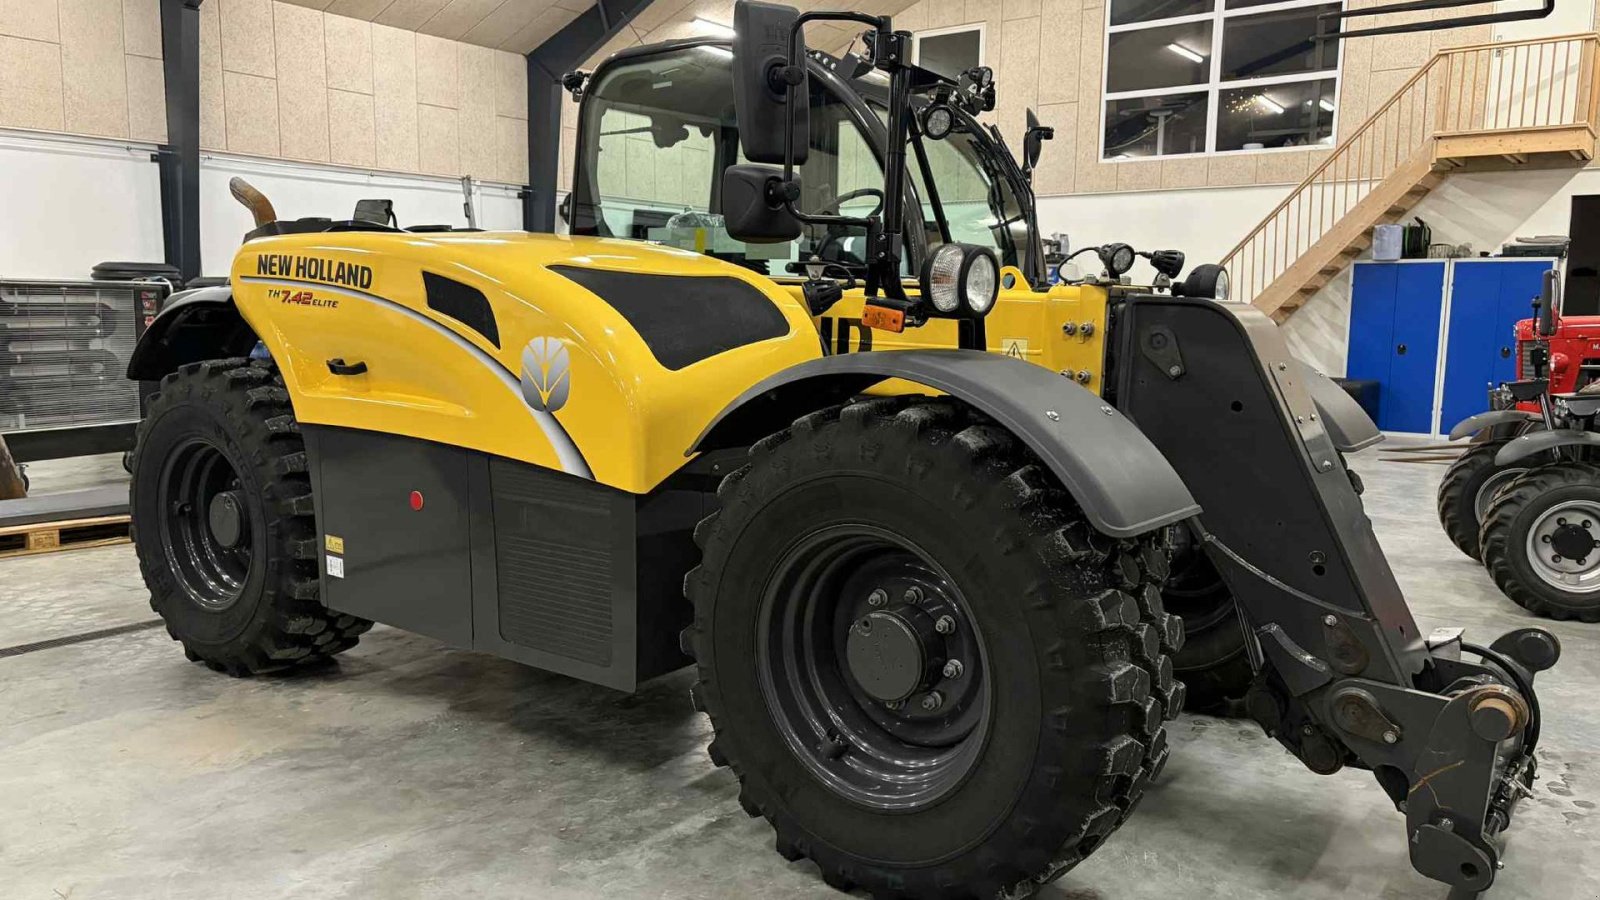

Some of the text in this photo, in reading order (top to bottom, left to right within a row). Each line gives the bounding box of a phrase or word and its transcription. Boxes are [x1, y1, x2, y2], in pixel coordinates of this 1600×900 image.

[257, 254, 373, 289] NEW HOLLAND
[312, 298, 339, 308] ELITE
